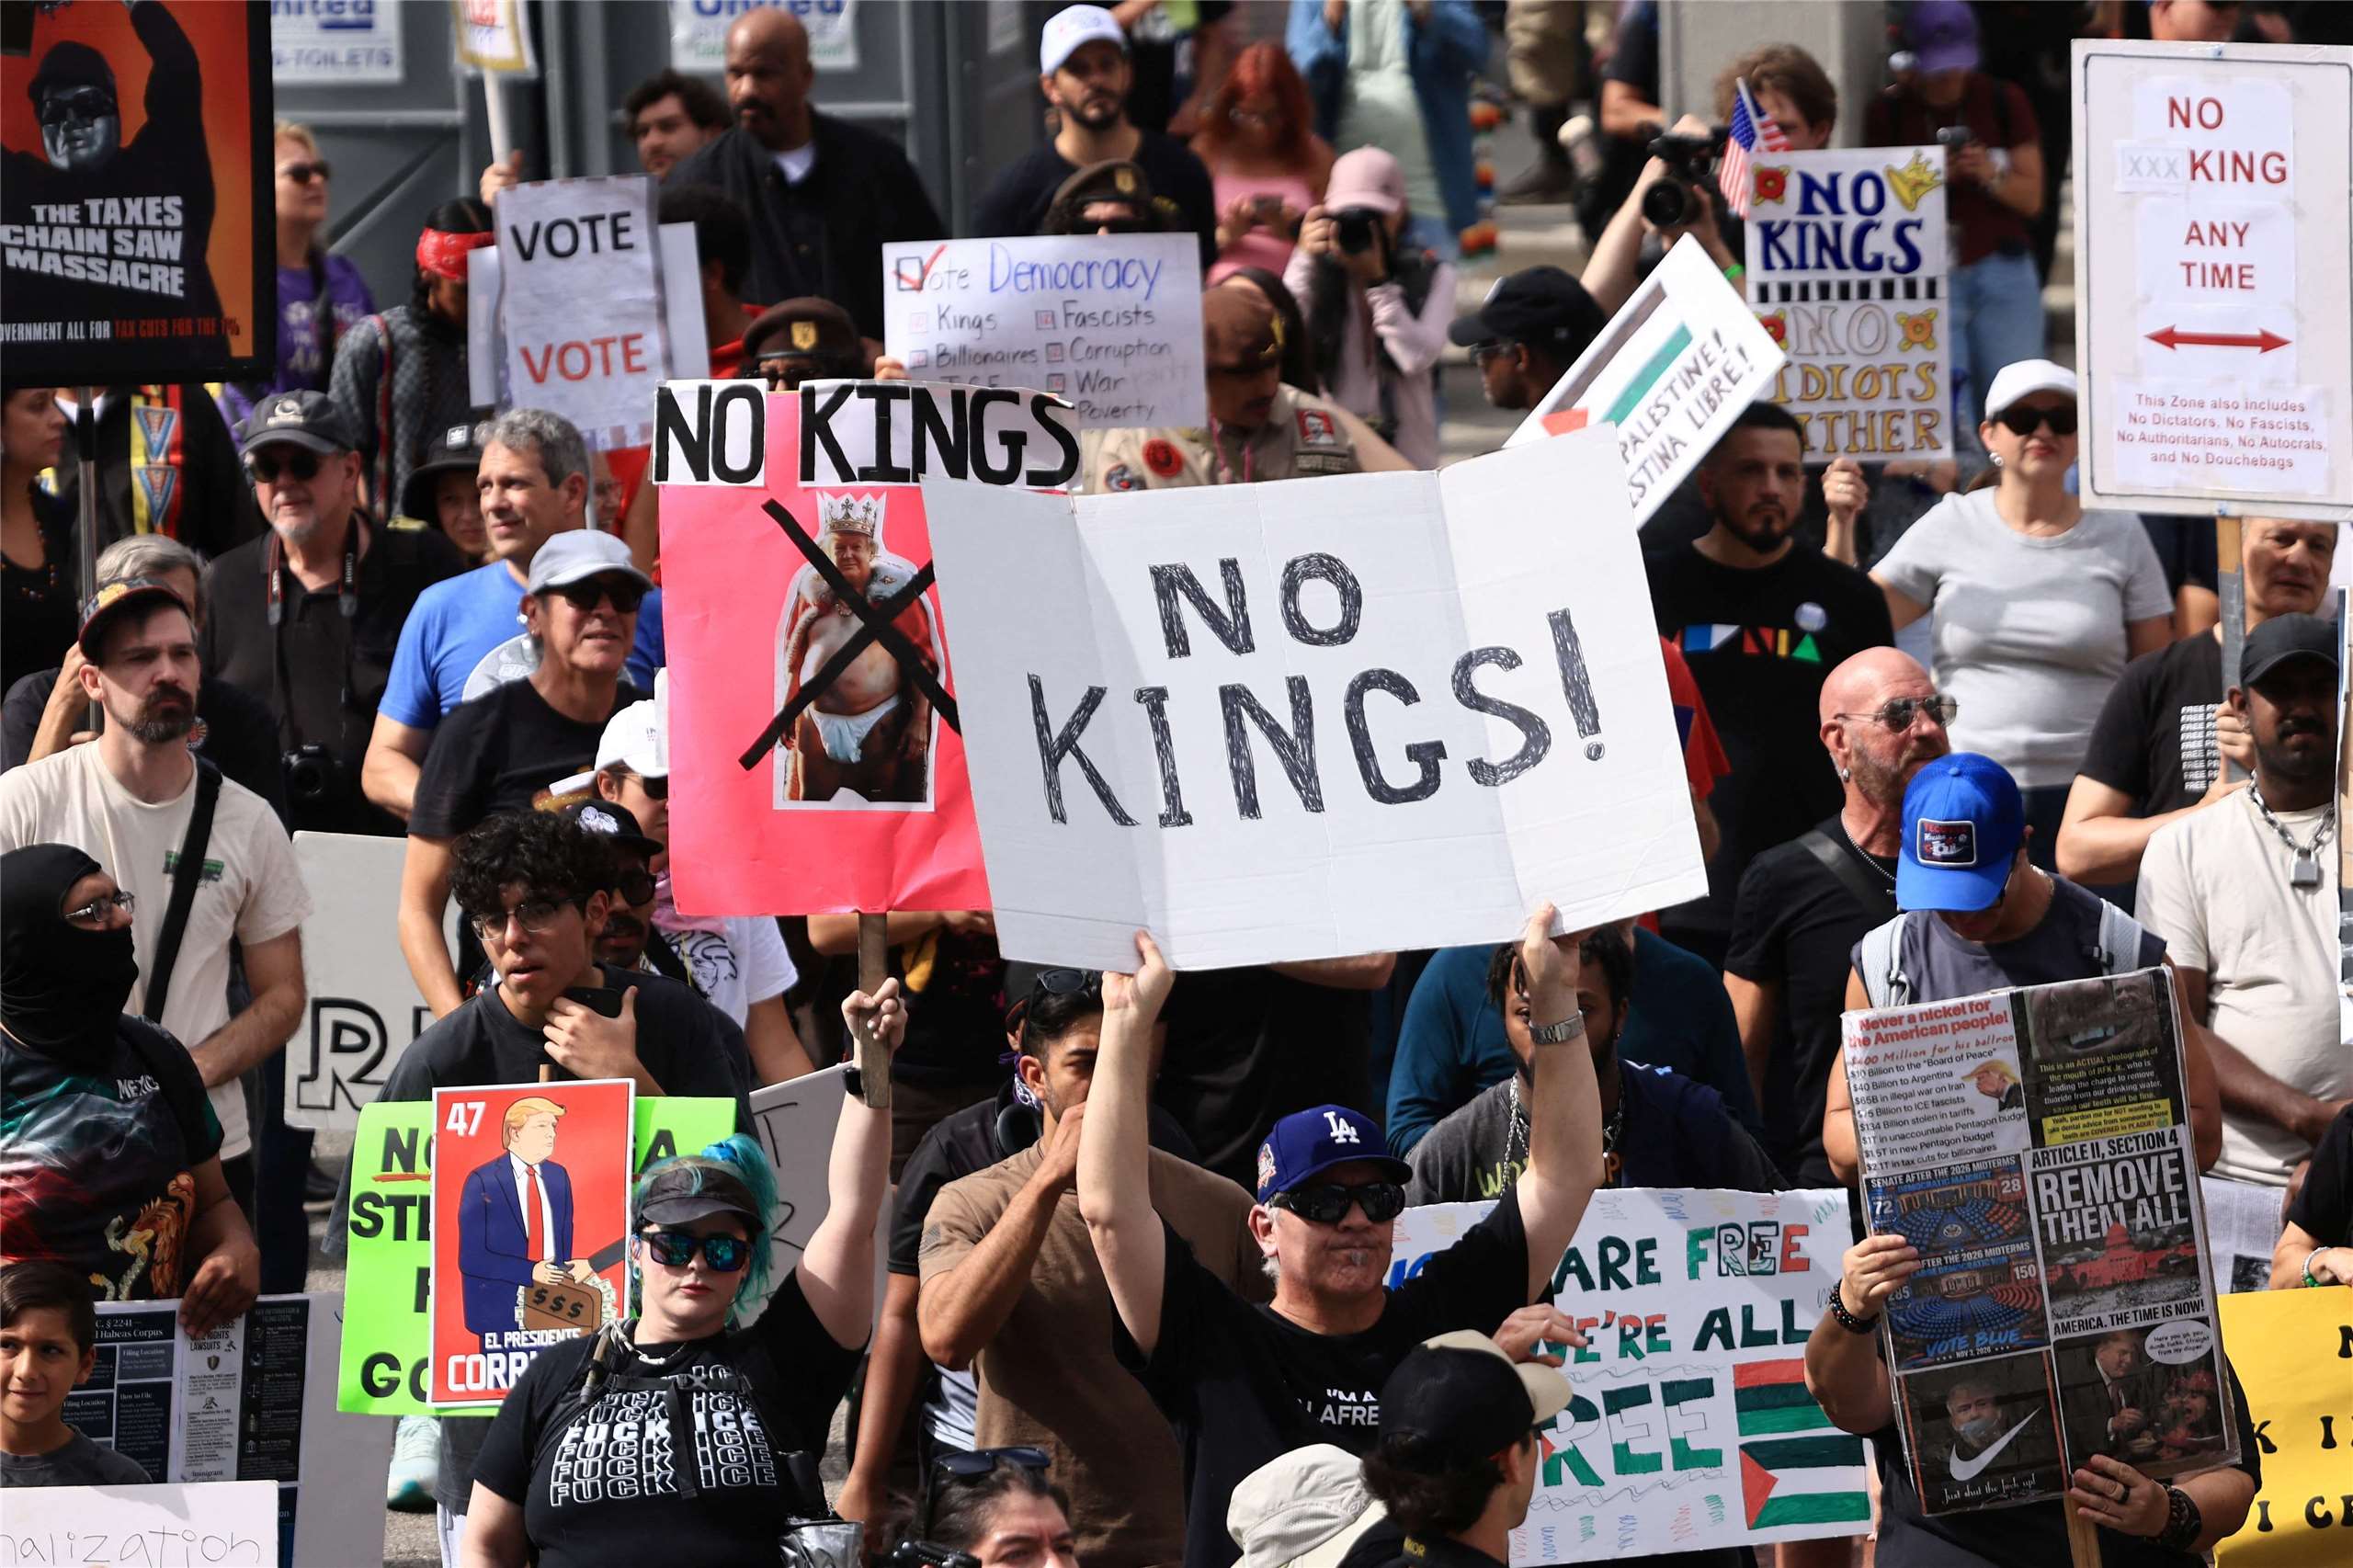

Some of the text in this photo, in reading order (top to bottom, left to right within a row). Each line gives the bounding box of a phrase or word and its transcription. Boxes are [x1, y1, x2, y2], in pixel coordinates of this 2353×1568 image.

[2167, 97, 2223, 130] NO
[2188, 149, 2287, 184] KING
[1796, 170, 1885, 217] NO
[31, 196, 183, 226] THE TAXES
[0, 224, 183, 261] CHAIN SAW
[510, 211, 634, 262] VOTE
[1756, 218, 1923, 274] KINGS
[2185, 221, 2250, 247] ANY
[5, 246, 184, 299] MASSACRE
[989, 243, 1161, 301] Democracy
[2180, 262, 2256, 290] TIME
[66, 322, 85, 339] ALL
[89, 321, 110, 338] FOR
[936, 304, 997, 339] Kings
[1063, 300, 1156, 326] Fascists
[1791, 304, 1888, 357] NO
[519, 333, 647, 384] VOTE
[936, 343, 1039, 369] Billionaires
[1069, 336, 1172, 369] Corruption
[1074, 370, 1125, 393] War
[1619, 327, 1727, 465] PALESTINE!
[1685, 344, 1755, 431] LIBRE!
[1768, 361, 1938, 404] IDIOTS
[2136, 393, 2305, 412] This Zone also includes
[654, 384, 1081, 487] NO KINGS
[1794, 408, 1943, 454] ITHER
[2128, 412, 2147, 425] No
[2225, 415, 2245, 428] No
[2117, 430, 2134, 442] No
[2238, 434, 2256, 448] No
[2150, 450, 2294, 471] and No Douchebags
[1149, 551, 1362, 659] NO
[1027, 607, 1607, 828] KINGS!
[1859, 999, 1991, 1031] Never a nickel for
[1874, 1023, 1949, 1045] American
[1951, 1010, 2008, 1035] people!
[1906, 1061, 1922, 1072] the
[1911, 1070, 1953, 1086] Argentina
[446, 1101, 486, 1137] 47
[1911, 1112, 1938, 1126] stolen
[1915, 1099, 1929, 1110] ICE
[1931, 1095, 1966, 1108] fascists
[1324, 1111, 1360, 1143] LA
[1890, 1117, 1997, 1142] unaccountable Pentagon
[1919, 1135, 1961, 1153] Pentagon
[1962, 1131, 1995, 1145] budget
[2032, 1129, 2178, 1169] ARTICLE II, SECTION 4
[1870, 1175, 1904, 1188] SENATE
[1905, 1169, 1930, 1185] AFTER
[1933, 1166, 1949, 1179] THE
[1972, 1155, 2016, 1172] MIDTERMS
[2001, 1179, 2022, 1194] 28
[2036, 1152, 2184, 1213] REMOVE
[1872, 1200, 1893, 1215] 72
[2041, 1201, 2127, 1245] THEM
[2136, 1193, 2188, 1233] ALL
[1553, 1221, 1811, 1294] ARE FREE
[1943, 1252, 1961, 1266] THE
[1984, 1241, 2030, 1258] MIDTERMS
[2013, 1264, 2037, 1280] 150
[100, 1328, 164, 1339] Habeas Corpus
[1692, 1298, 1813, 1352] ALL
[2053, 1299, 2205, 1336] AMERICA. THE TIME IS NOW!
[190, 1341, 221, 1352] LAWSUITS
[485, 1333, 502, 1349] EL
[1926, 1329, 2021, 1358] VOTE BLUE
[448, 1351, 539, 1392] CORR
[562, 1411, 762, 1446] FUCK ICE
[1539, 1376, 1723, 1489] REE
[555, 1429, 768, 1463] FUCK ICE
[551, 1446, 774, 1485] FUCK ICE
[550, 1465, 777, 1507] FUCK ICE
